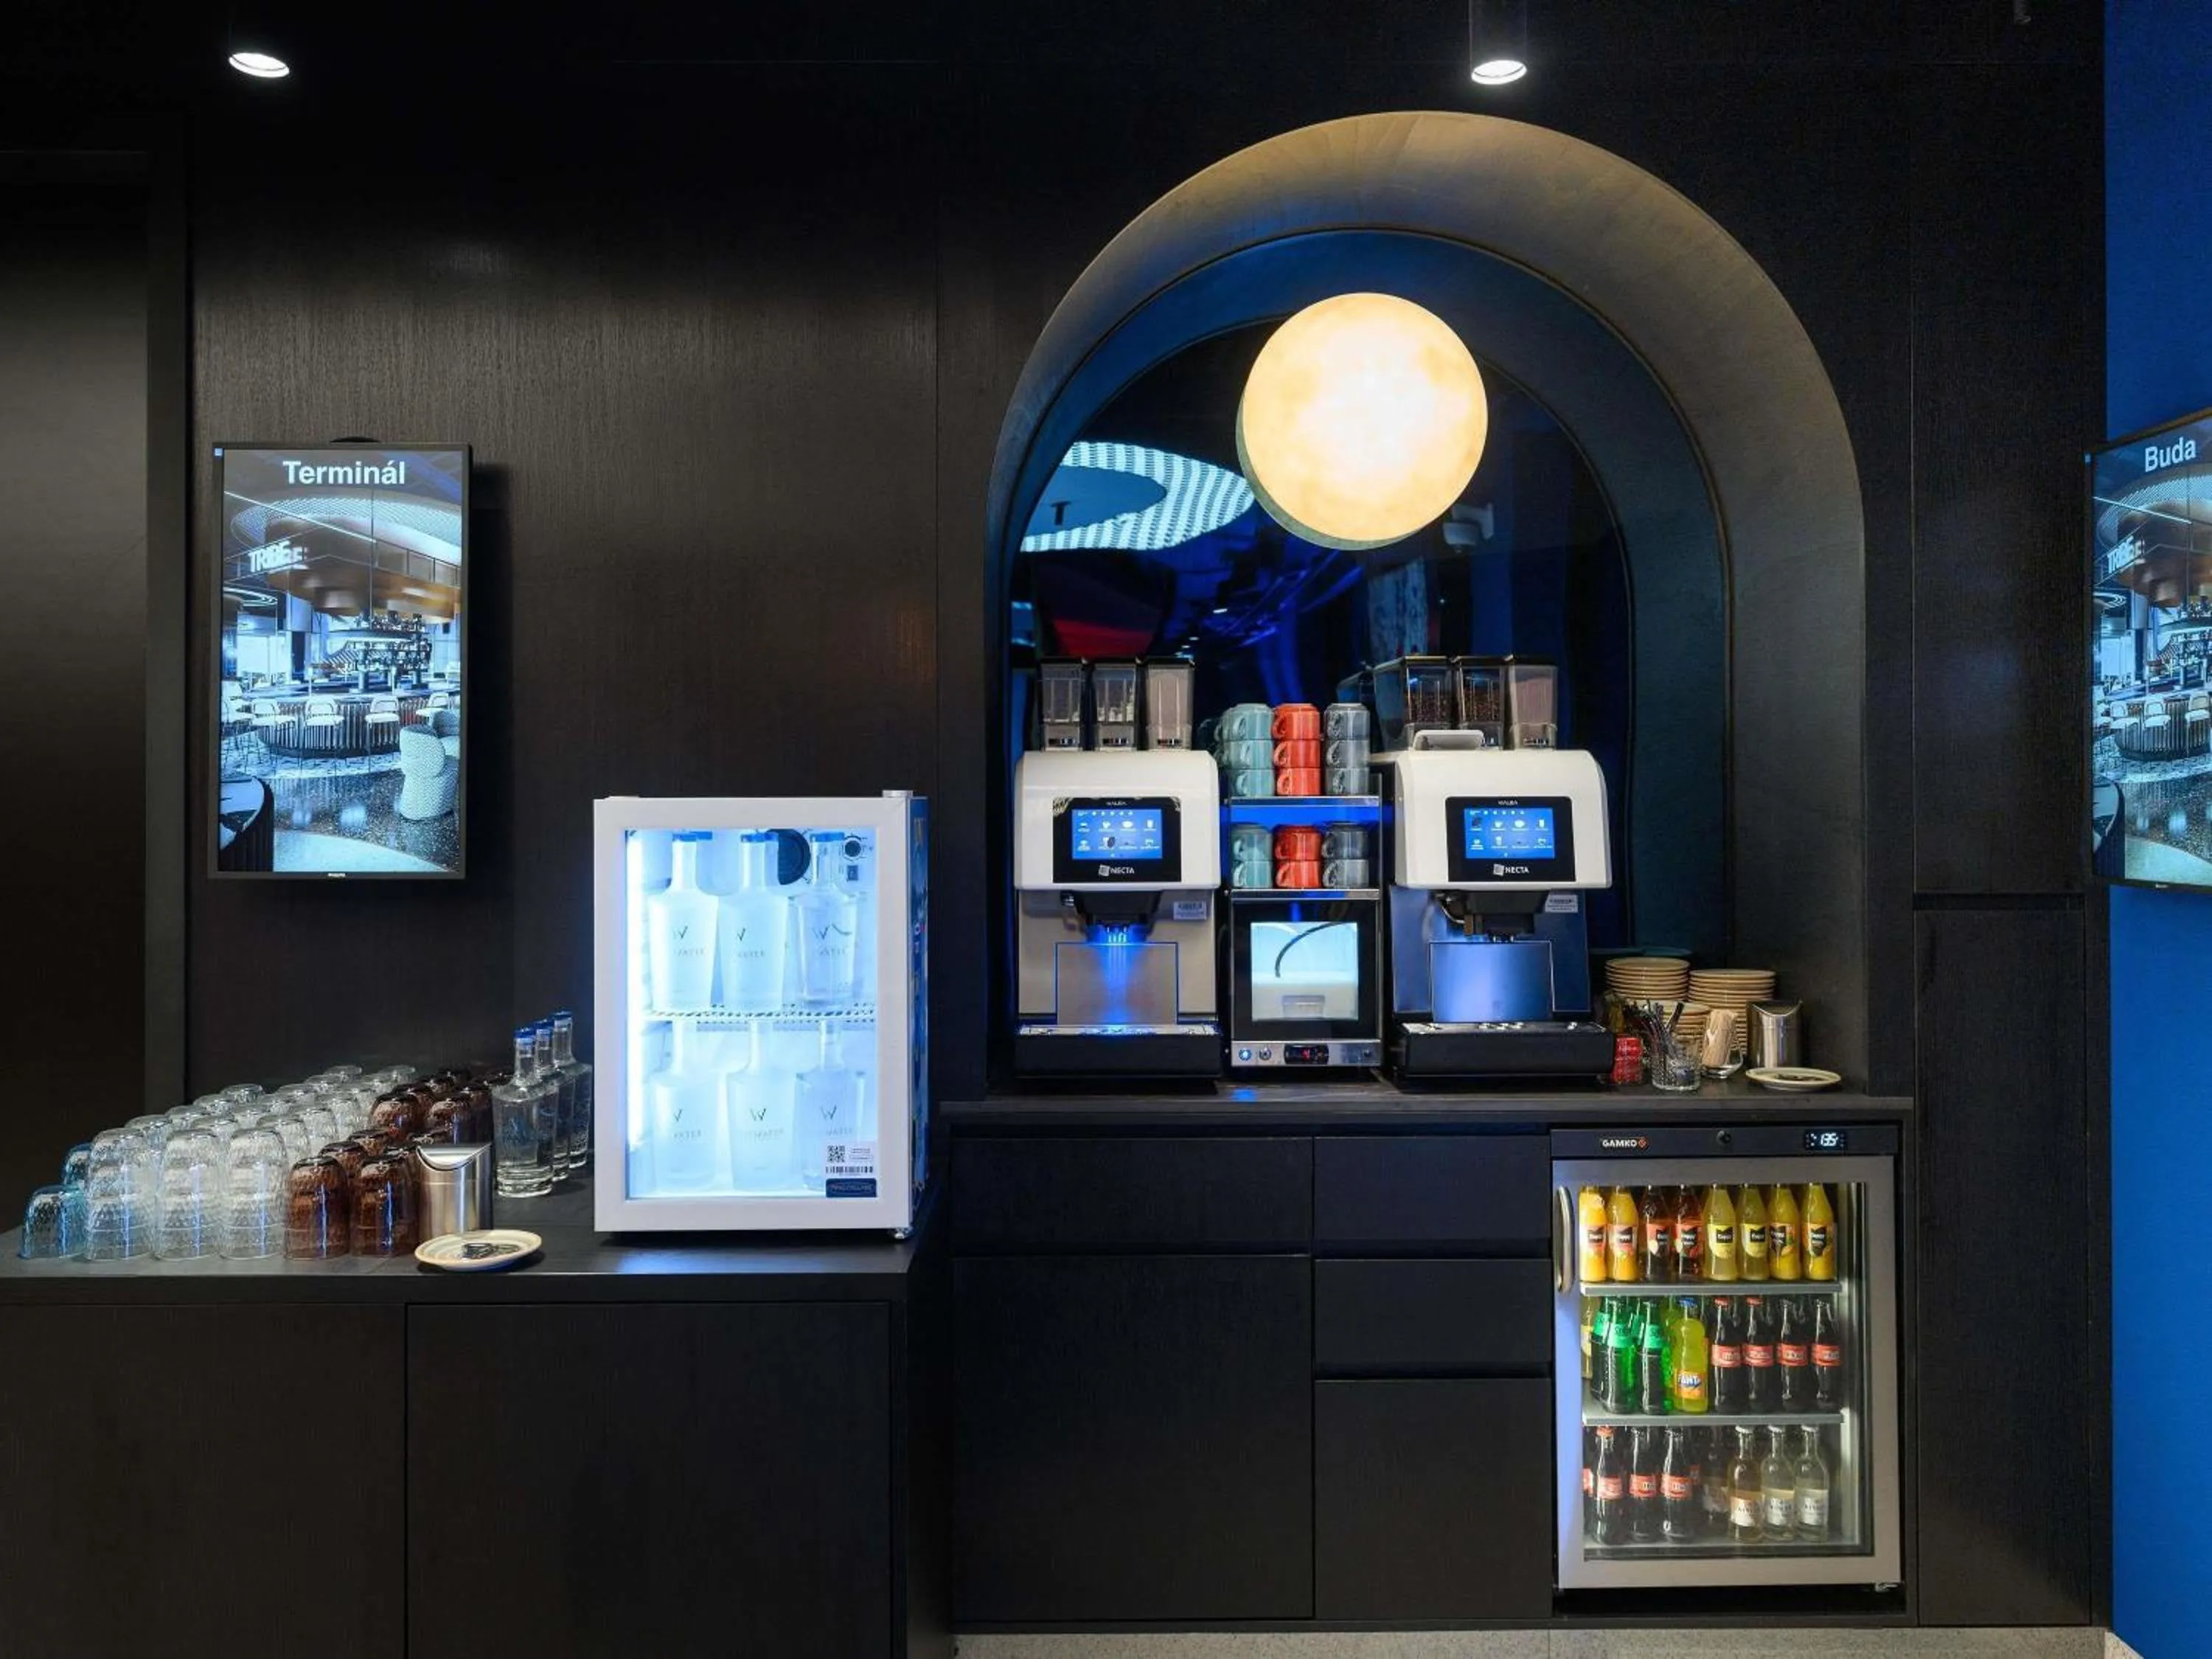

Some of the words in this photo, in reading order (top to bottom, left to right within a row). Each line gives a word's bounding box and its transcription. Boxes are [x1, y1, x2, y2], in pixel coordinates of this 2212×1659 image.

[2145, 436, 2197, 473] Buda
[282, 460, 406, 484] Terminál
[1110, 866, 1135, 874] NECTA
[1602, 1138, 1638, 1148] GAMKO
